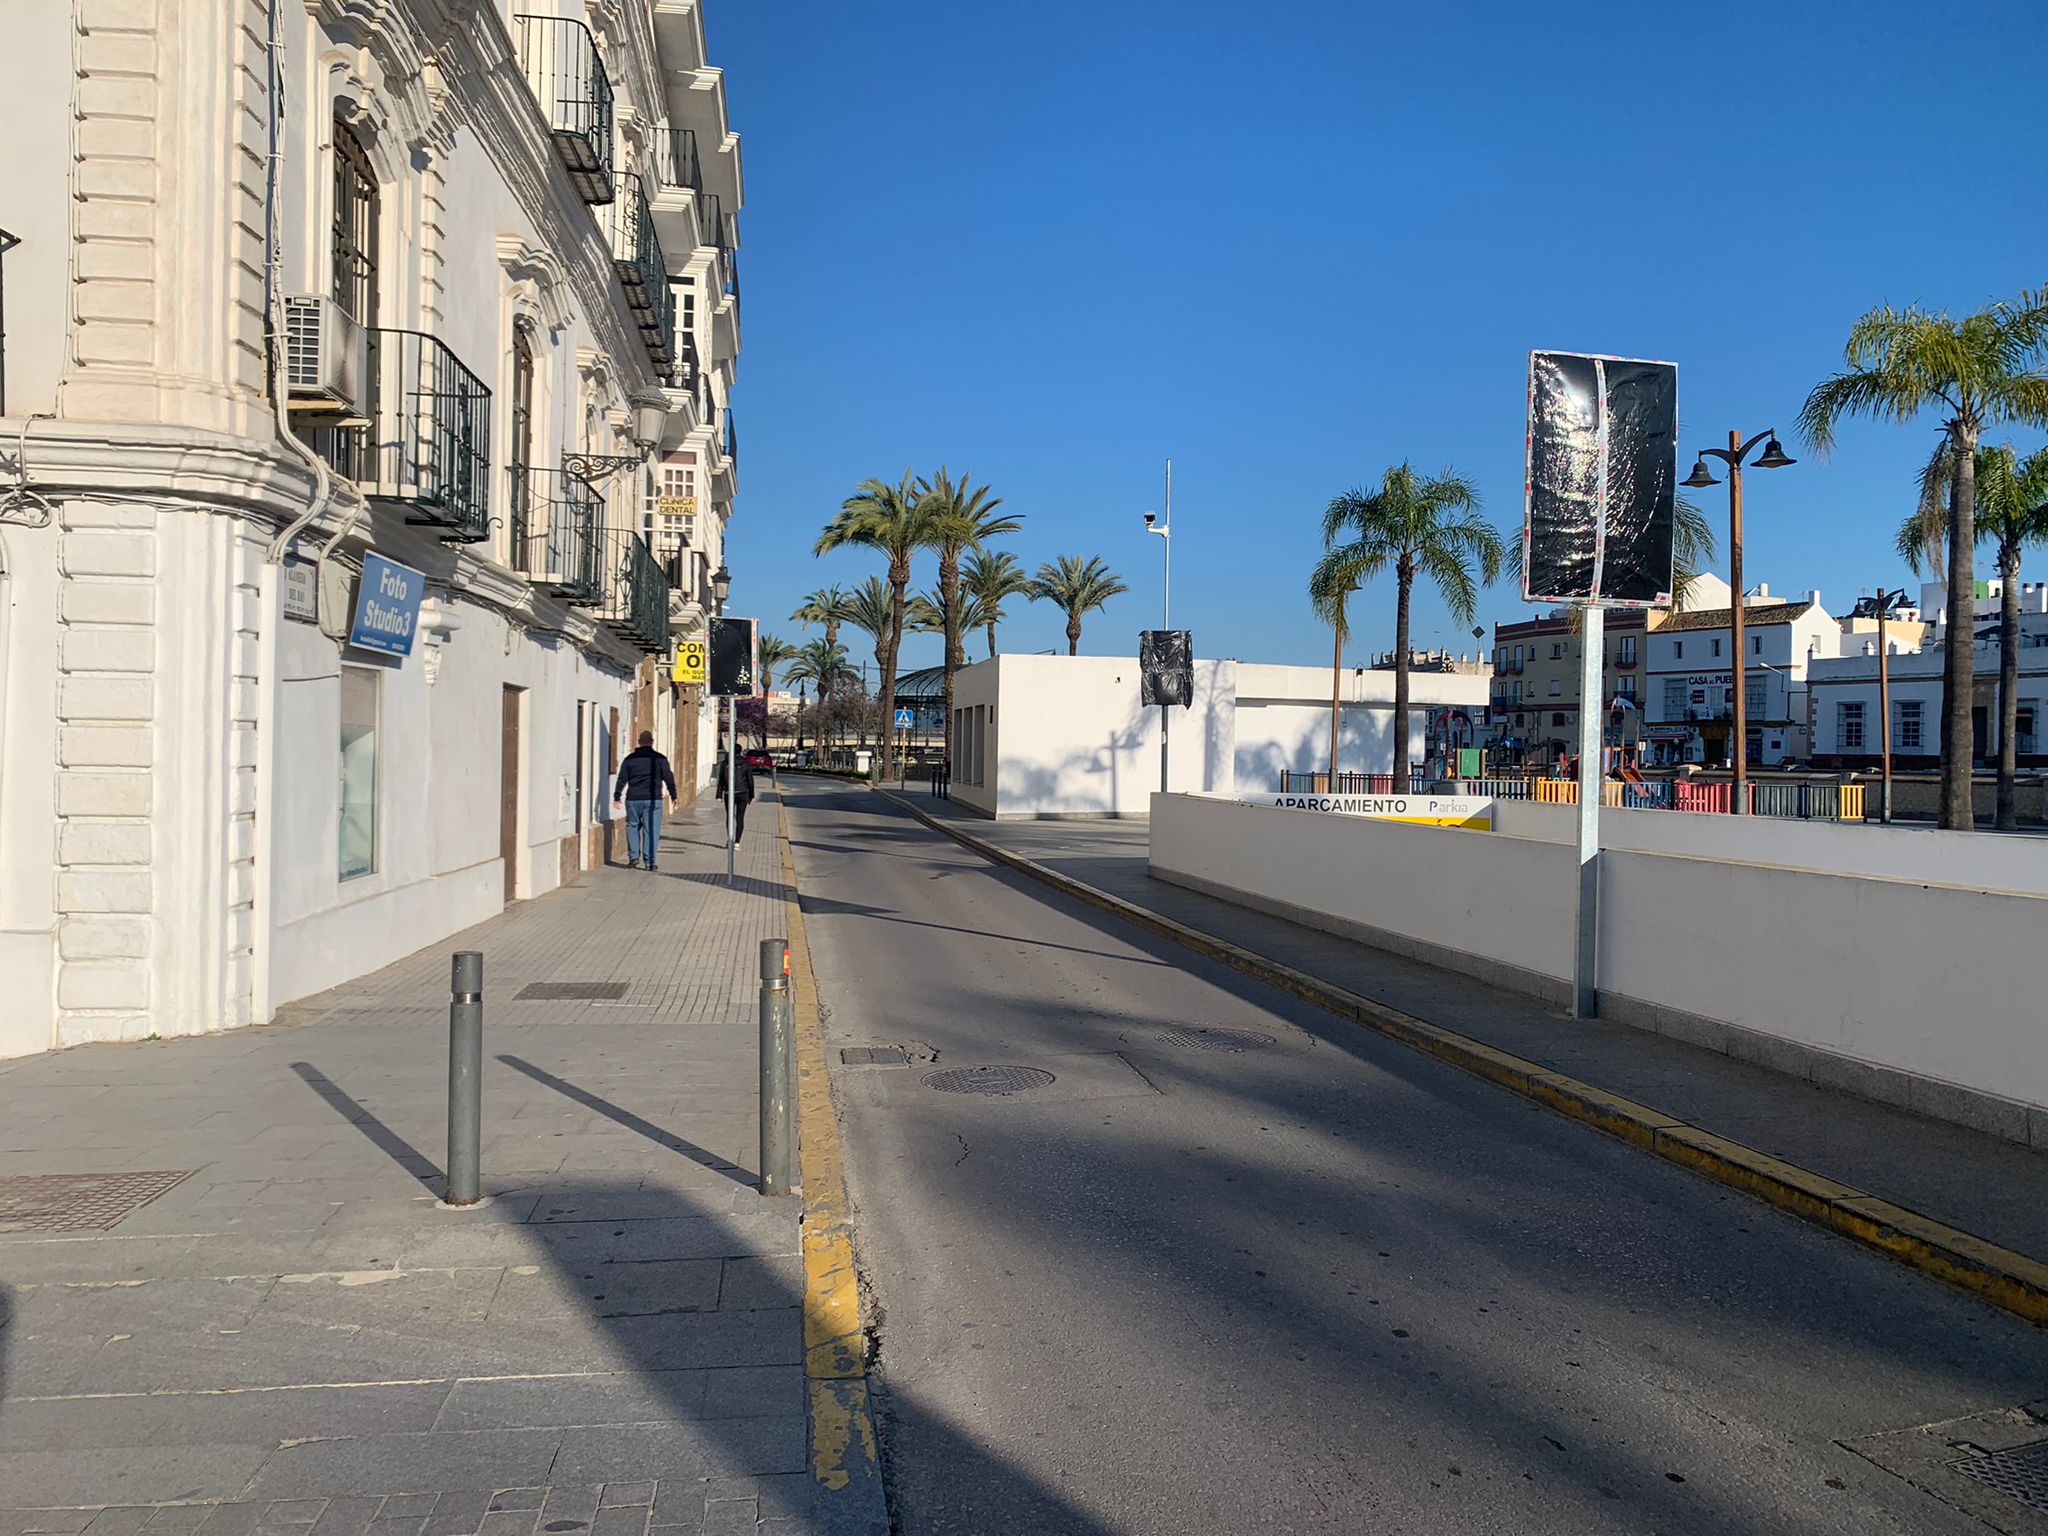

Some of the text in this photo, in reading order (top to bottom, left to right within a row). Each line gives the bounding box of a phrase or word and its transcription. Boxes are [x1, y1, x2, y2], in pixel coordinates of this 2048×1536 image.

[659, 506, 694, 514] DENTAL
[380, 567, 408, 601] Foto
[364, 600, 411, 637] Studio3
[686, 654, 705, 668] O
[1689, 676, 1708, 685] CASA
[1274, 798, 1468, 813] APARCAMIENTO Parkia
